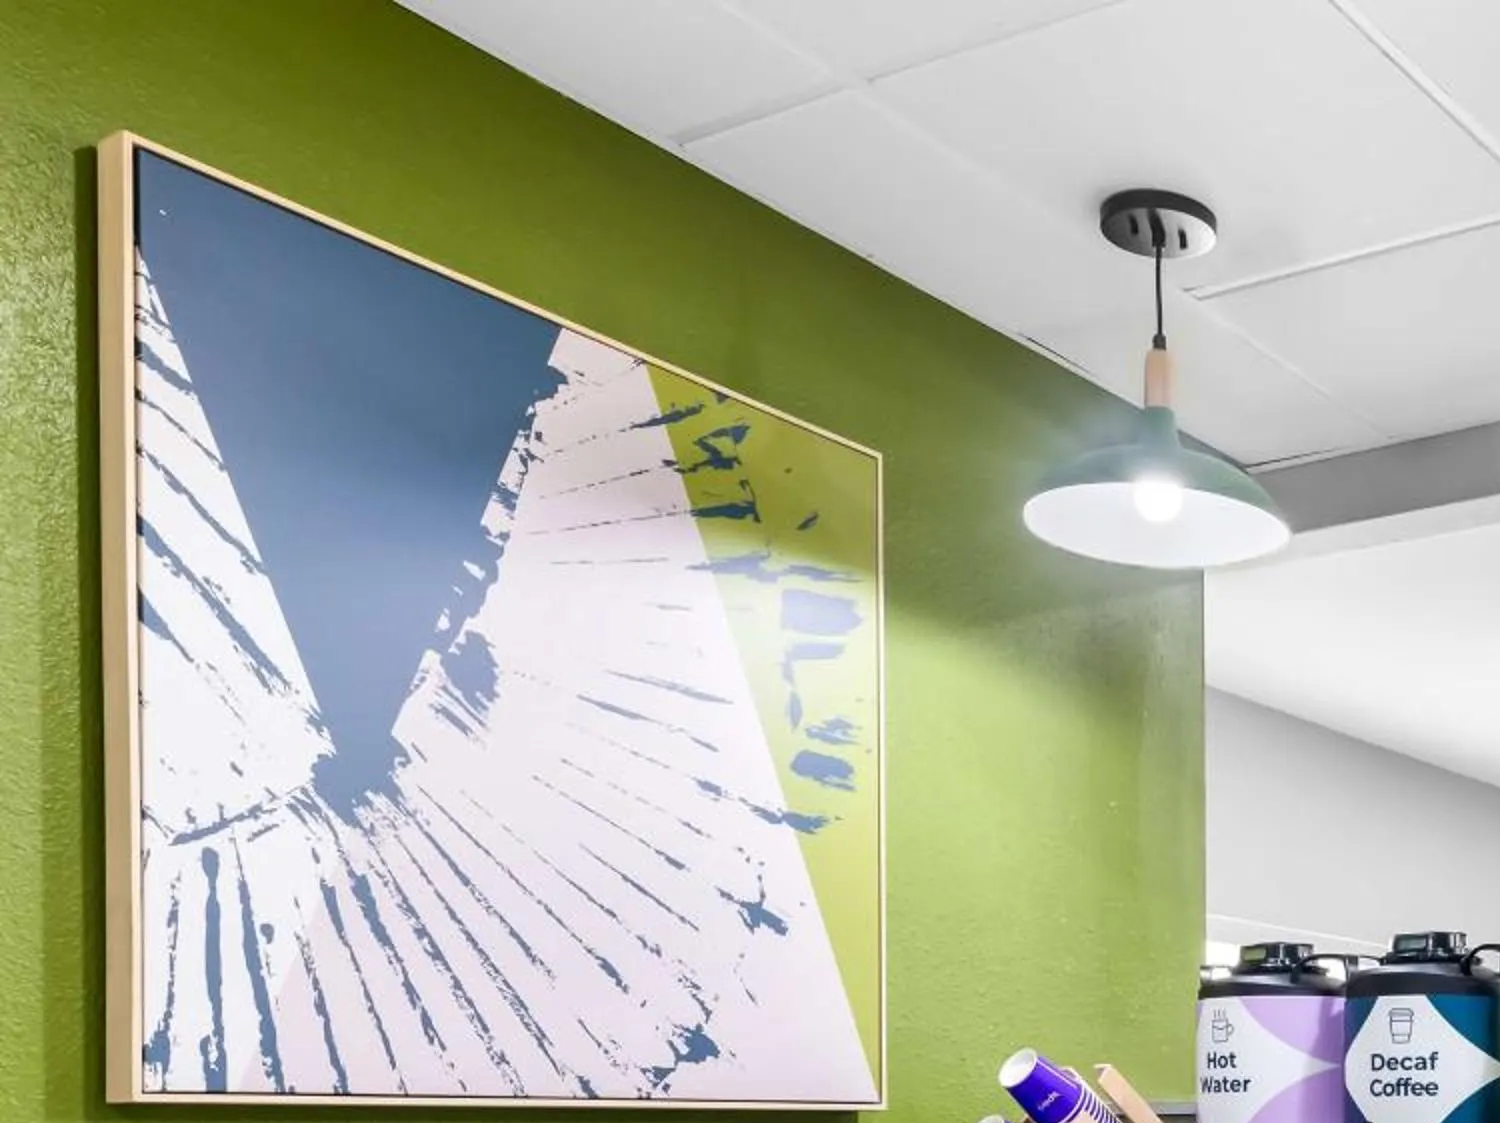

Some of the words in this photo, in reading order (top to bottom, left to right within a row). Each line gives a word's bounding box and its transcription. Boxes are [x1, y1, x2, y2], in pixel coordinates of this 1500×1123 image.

[1206, 1051, 1238, 1069] Hot
[1370, 1051, 1439, 1072] Decaf
[1200, 1075, 1252, 1094] Water
[1369, 1078, 1439, 1098] Coffee
